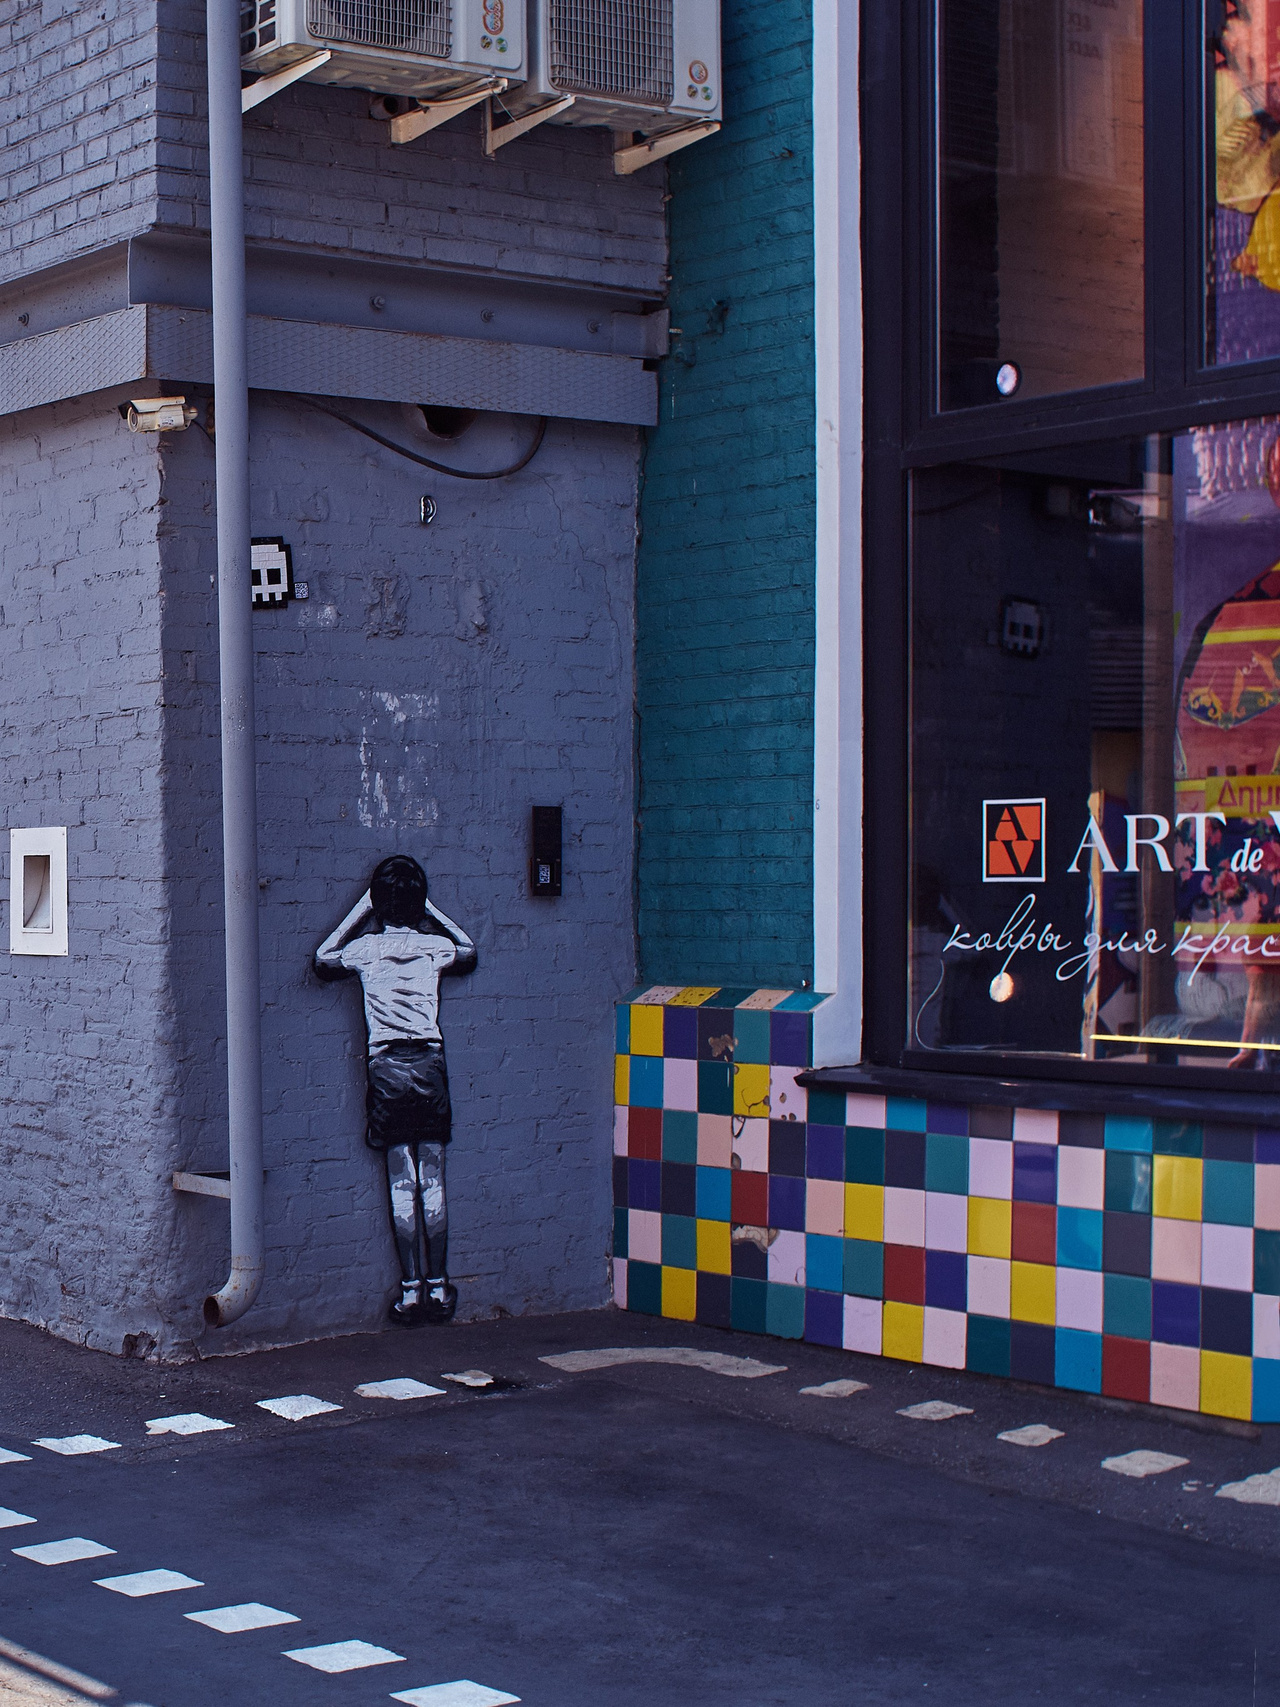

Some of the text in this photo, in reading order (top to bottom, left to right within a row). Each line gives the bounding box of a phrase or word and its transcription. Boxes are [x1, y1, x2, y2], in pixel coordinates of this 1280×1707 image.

[1066, 812, 1228, 873] ART
[1230, 838, 1264, 873] de
[943, 893, 1072, 977] ковры
[1055, 928, 1167, 981] для
